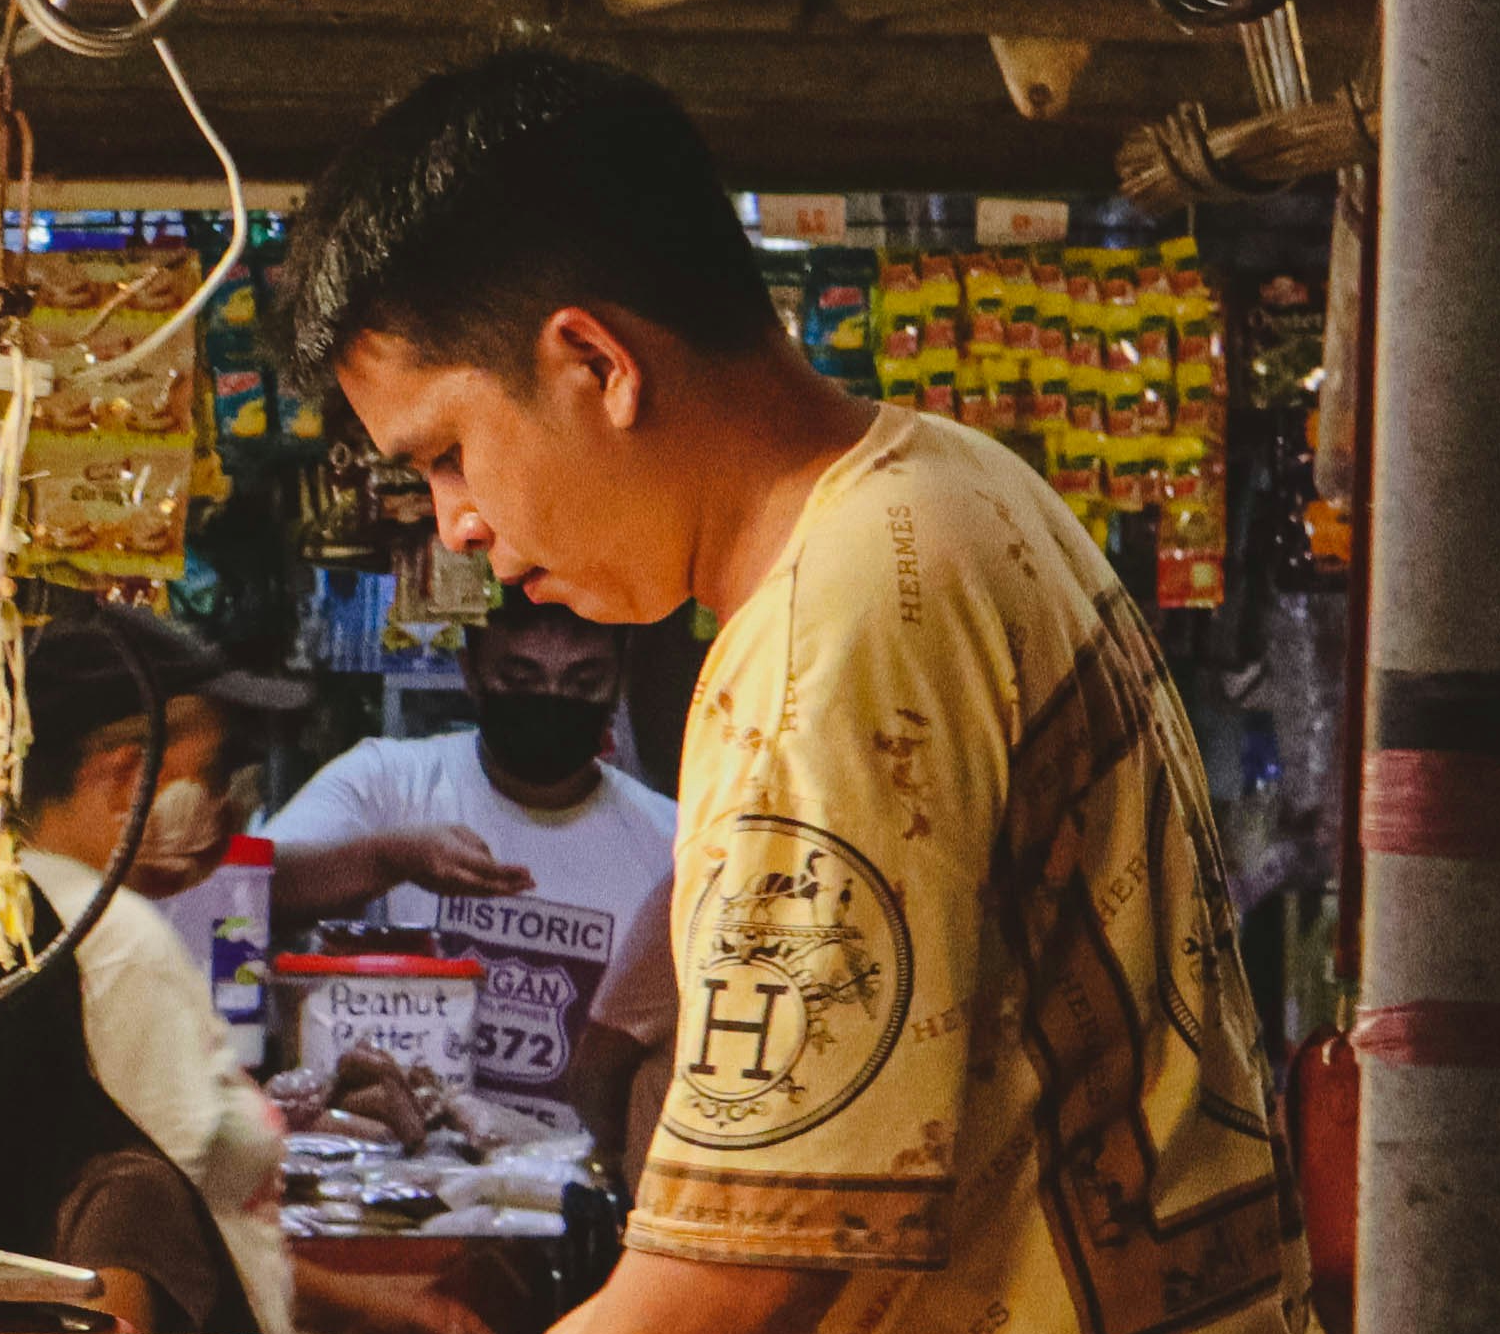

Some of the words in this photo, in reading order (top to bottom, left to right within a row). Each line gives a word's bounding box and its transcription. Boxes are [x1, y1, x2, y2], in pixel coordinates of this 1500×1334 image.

[446, 895, 605, 952] HISTORIC
[329, 981, 449, 1018] Peanut
[687, 978, 790, 1081] H
